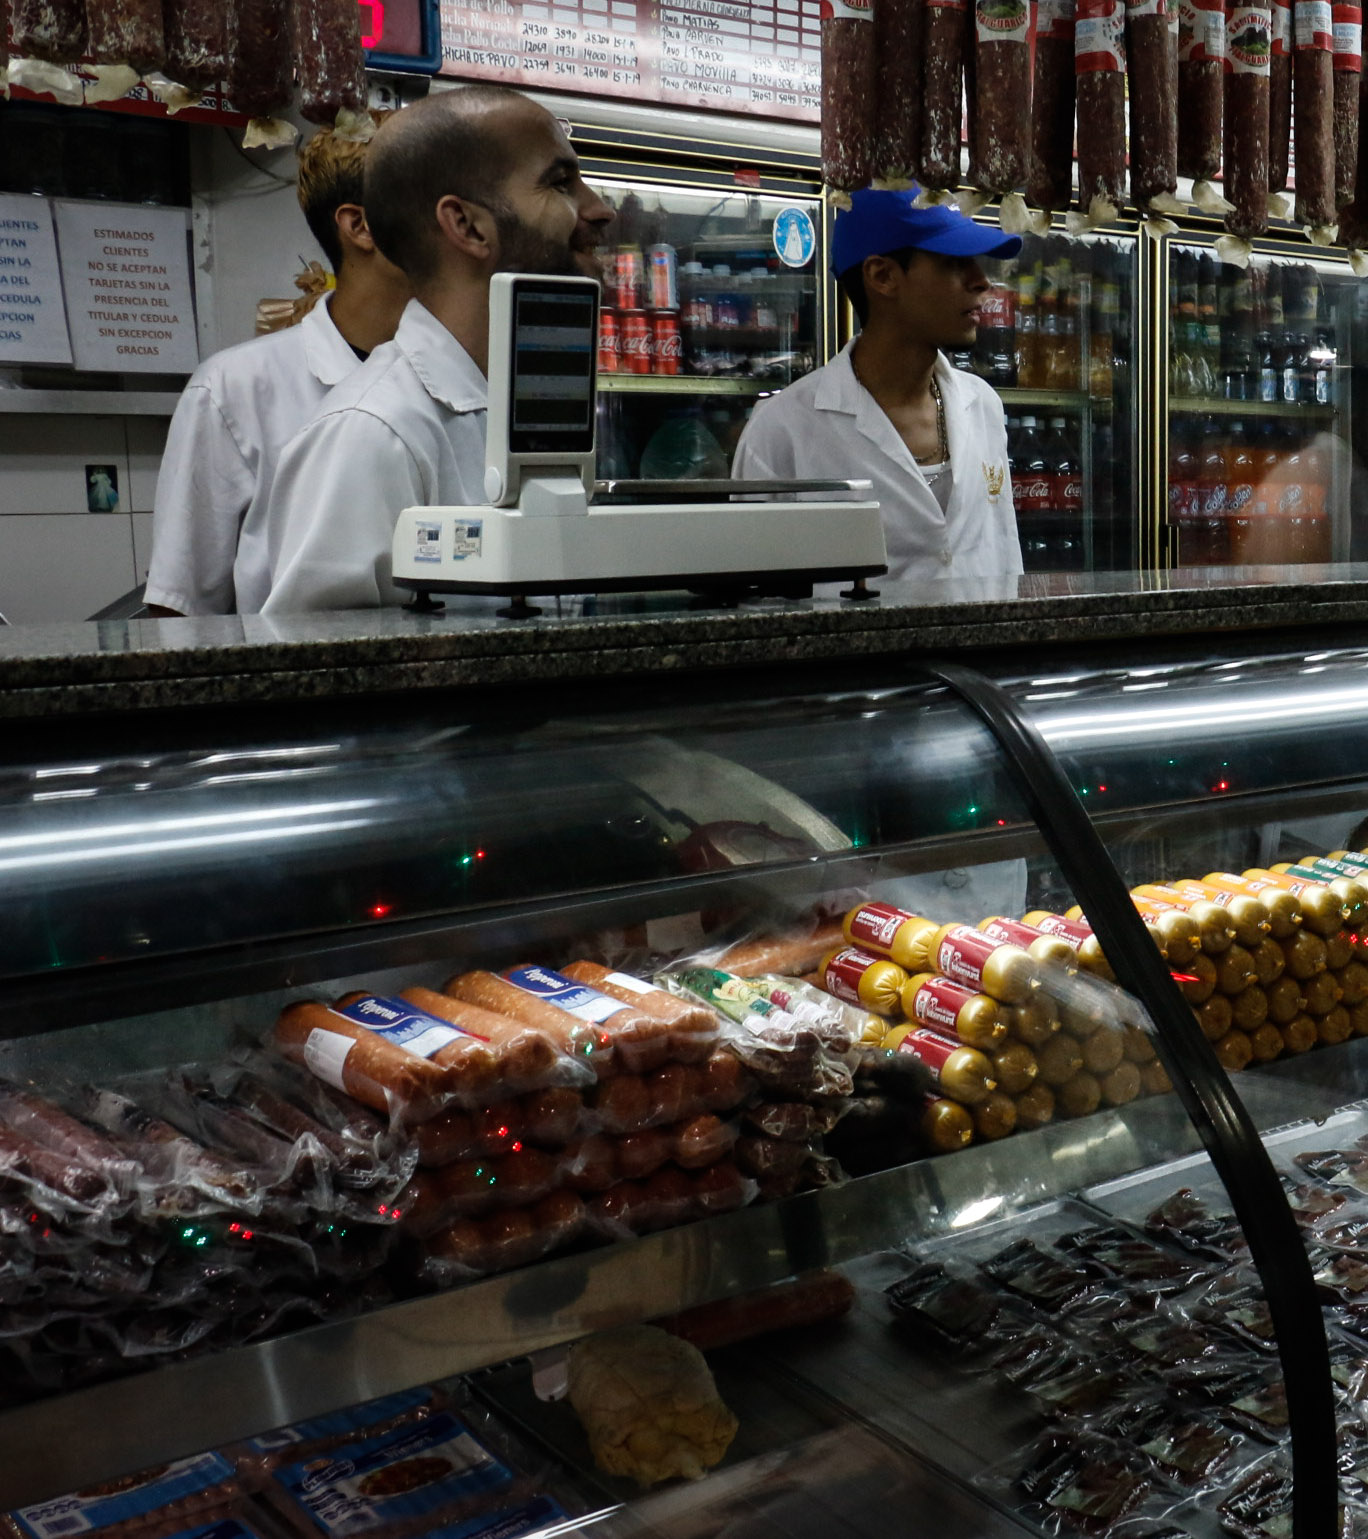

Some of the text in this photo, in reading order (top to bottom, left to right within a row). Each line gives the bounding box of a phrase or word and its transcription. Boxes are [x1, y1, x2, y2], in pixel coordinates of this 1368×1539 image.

[683, 14, 720, 30] MATIAS
[522, 23, 548, 37] 24310
[554, 28, 577, 40] 3890
[524, 40, 547, 52] 12069
[555, 45, 575, 57] 1931
[584, 48, 606, 61] 14000
[473, 52, 485, 64] DE
[486, 53, 516, 68] PAVO
[555, 63, 575, 75] 3641
[584, 66, 609, 79] 26400
[94, 229, 155, 241] ESTIMADOS
[103, 246, 149, 257] CLIENTES
[18, 257, 31, 267] LA
[88, 261, 167, 275] NO SE ACEPTAN
[11, 276, 30, 286] DEL
[88, 278, 171, 291] TARJETAS SIN LA
[0, 293, 41, 304] CEDULA
[94, 295, 169, 308] PRESENCIA DEL
[88, 311, 179, 324] TITULAR Y CEDULA
[98, 328, 172, 340] SIN EXCEPCION
[116, 345, 160, 356] GRACIAS
